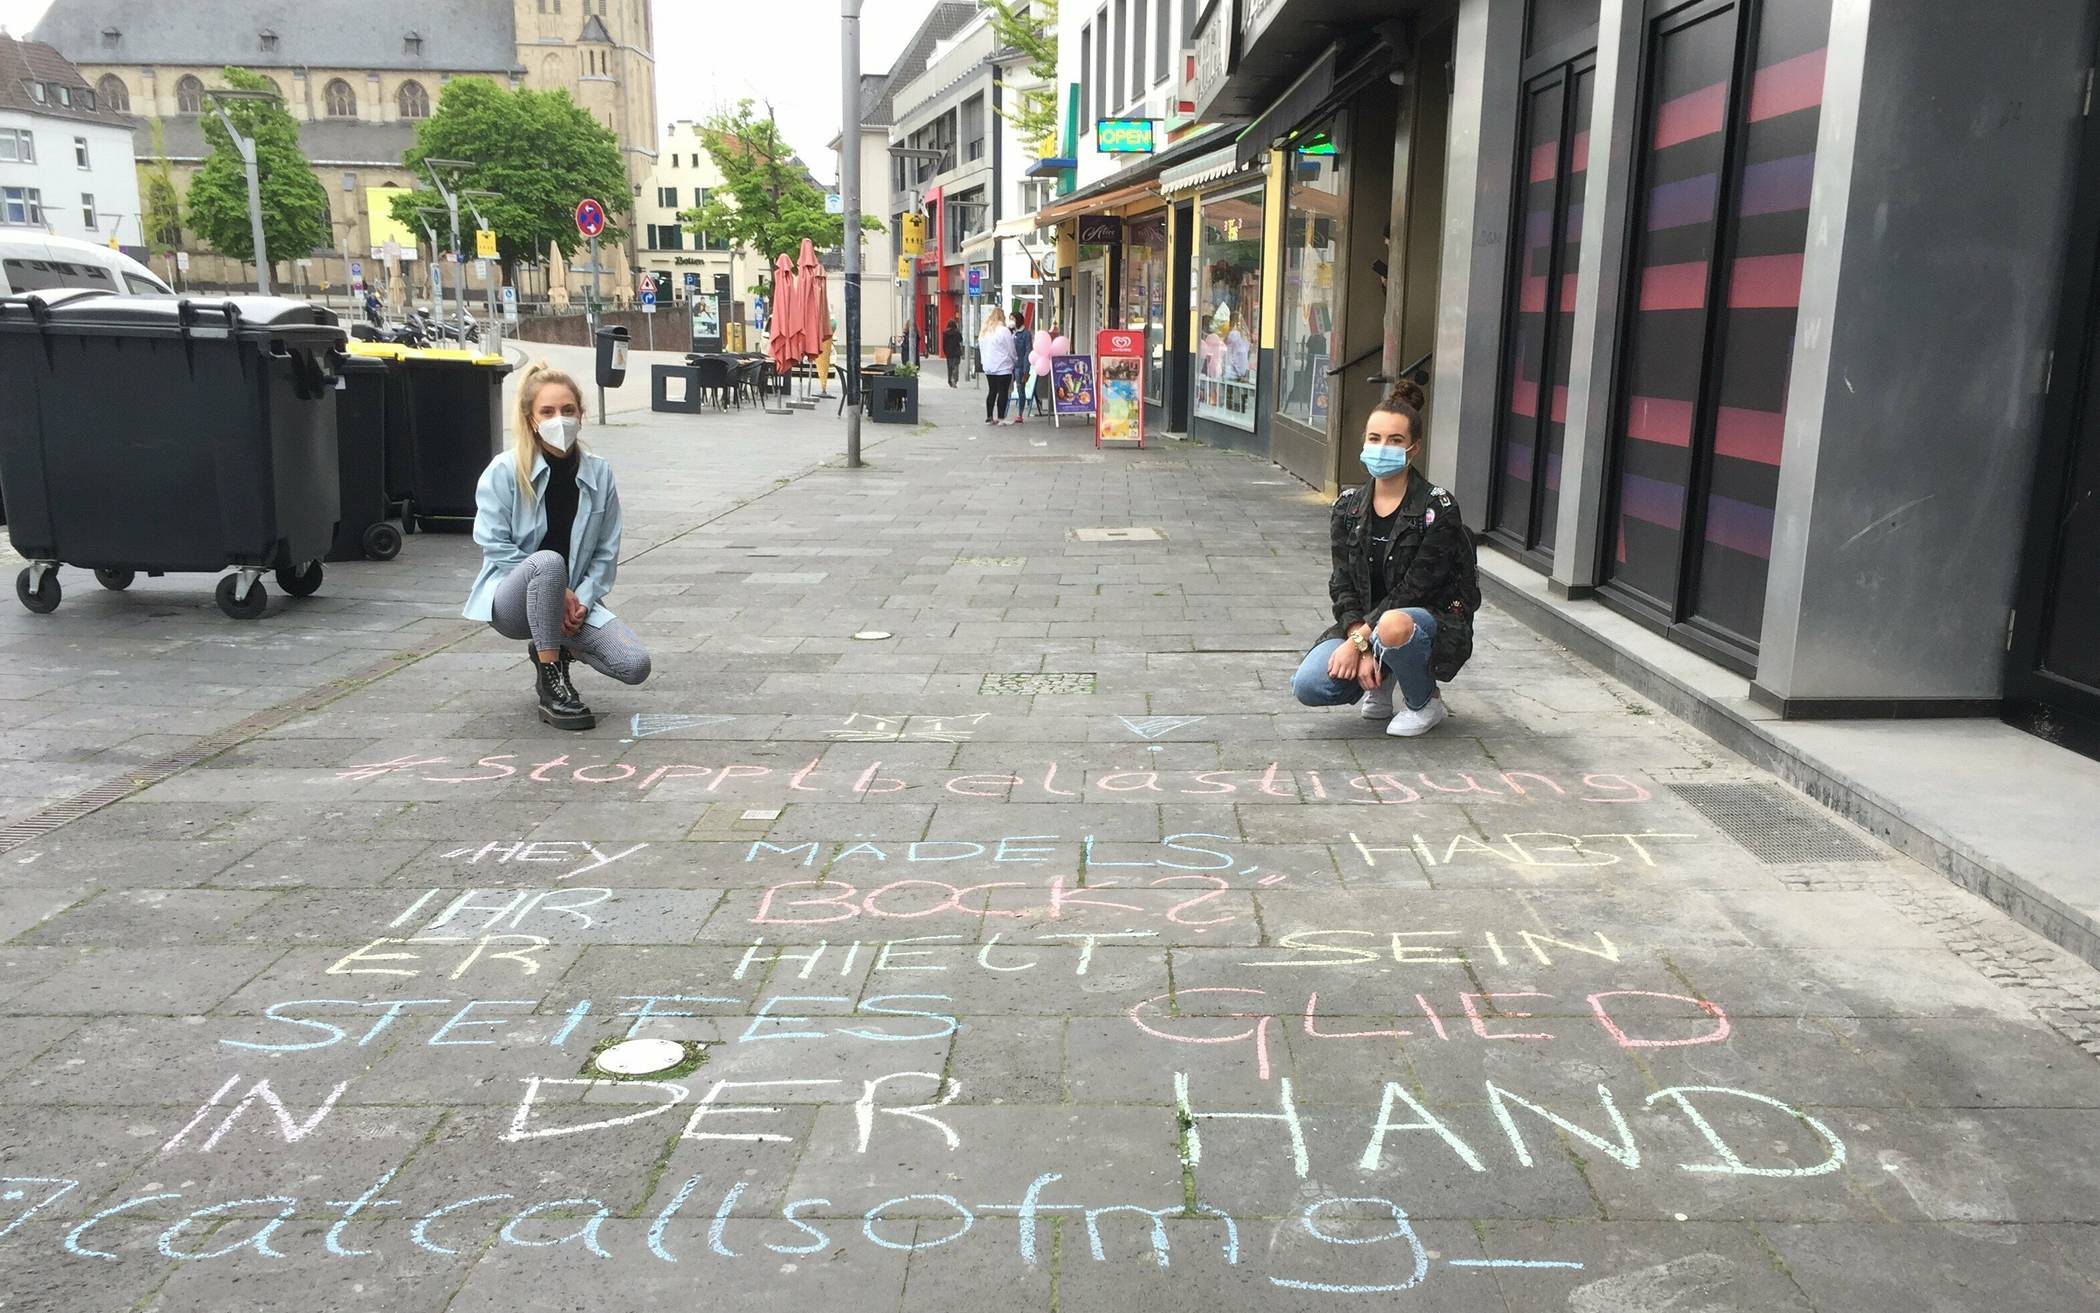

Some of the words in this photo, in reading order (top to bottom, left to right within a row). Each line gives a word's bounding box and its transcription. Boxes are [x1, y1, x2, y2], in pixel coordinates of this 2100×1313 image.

[1101, 128, 1152, 145] OPEN
[745, 832, 1259, 875] MÄDELS,
[1349, 832, 1697, 868] HABT
[390, 886, 615, 929] IHR
[324, 934, 551, 980] ER
[1238, 930, 1623, 968] SEIN
[220, 993, 961, 1052] STEIFES
[1129, 987, 1733, 1080] GLIED
[160, 1074, 348, 1154] IN
[497, 1071, 964, 1154] DER
[1173, 1072, 1848, 1180] HAND
